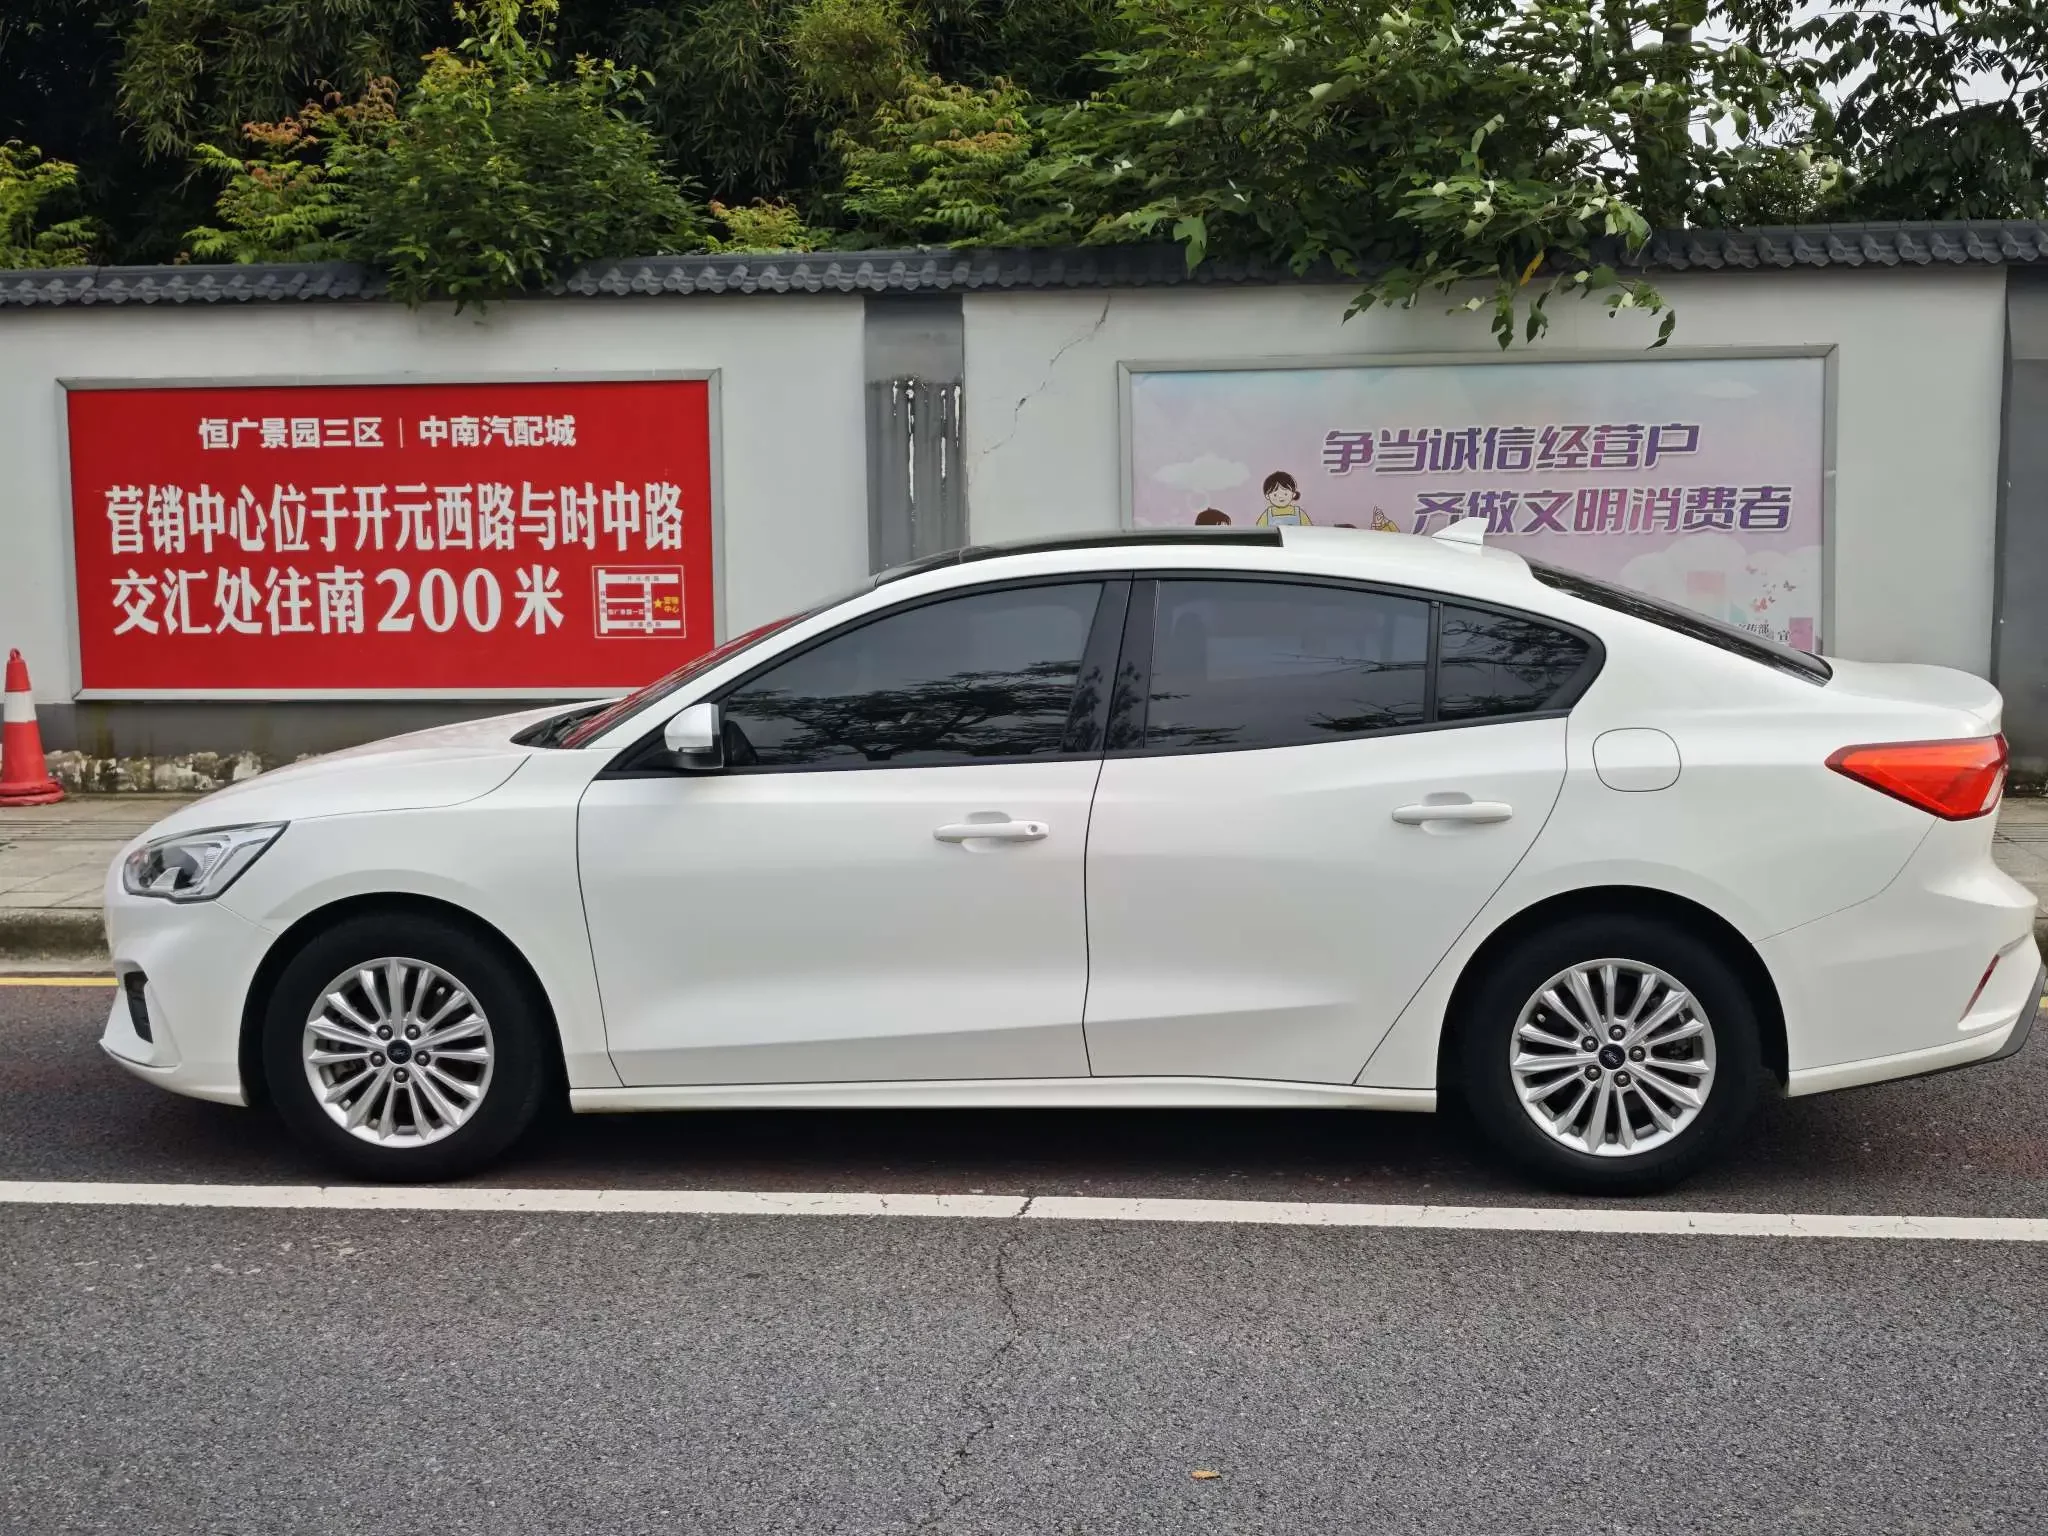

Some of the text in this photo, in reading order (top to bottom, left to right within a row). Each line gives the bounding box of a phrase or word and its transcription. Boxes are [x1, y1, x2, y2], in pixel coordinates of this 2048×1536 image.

[199, 415, 577, 449] 恒广景园三区 中南汽配城
[1322, 423, 1701, 474] 争当诚信经营户
[104, 481, 684, 555] 营销中心位于开元西路与时中路
[1412, 485, 1793, 535] 齐做文明消费者
[110, 564, 565, 636] 交汇处往南200米
